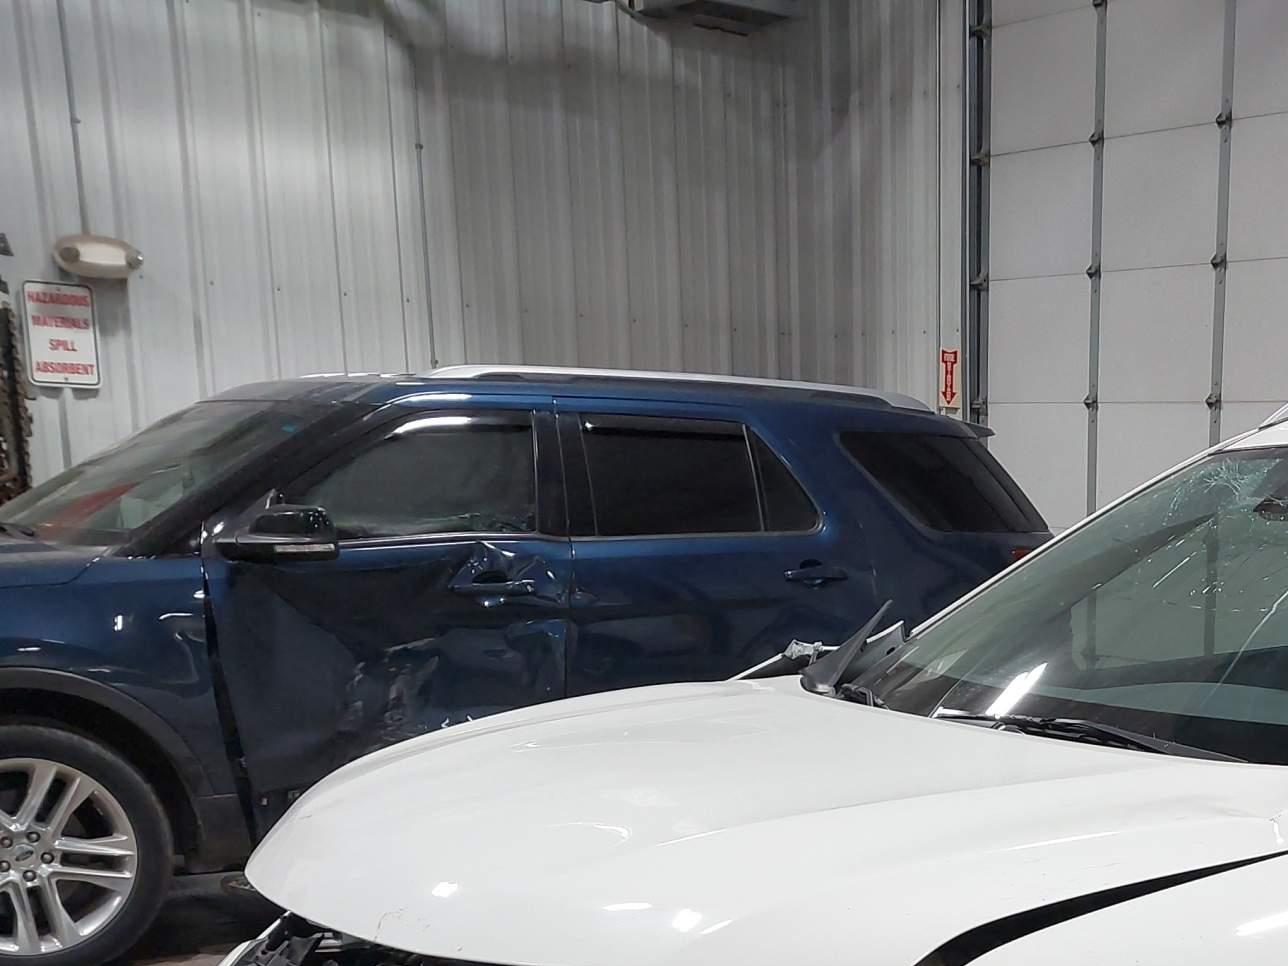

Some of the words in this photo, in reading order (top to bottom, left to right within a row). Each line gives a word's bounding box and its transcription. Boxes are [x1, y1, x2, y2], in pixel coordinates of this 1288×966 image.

[27, 291, 89, 307] HAZARDOUS
[31, 314, 90, 330] MATERIALS
[48, 338, 78, 352] SPILL
[35, 361, 94, 376] ABSORBENT
